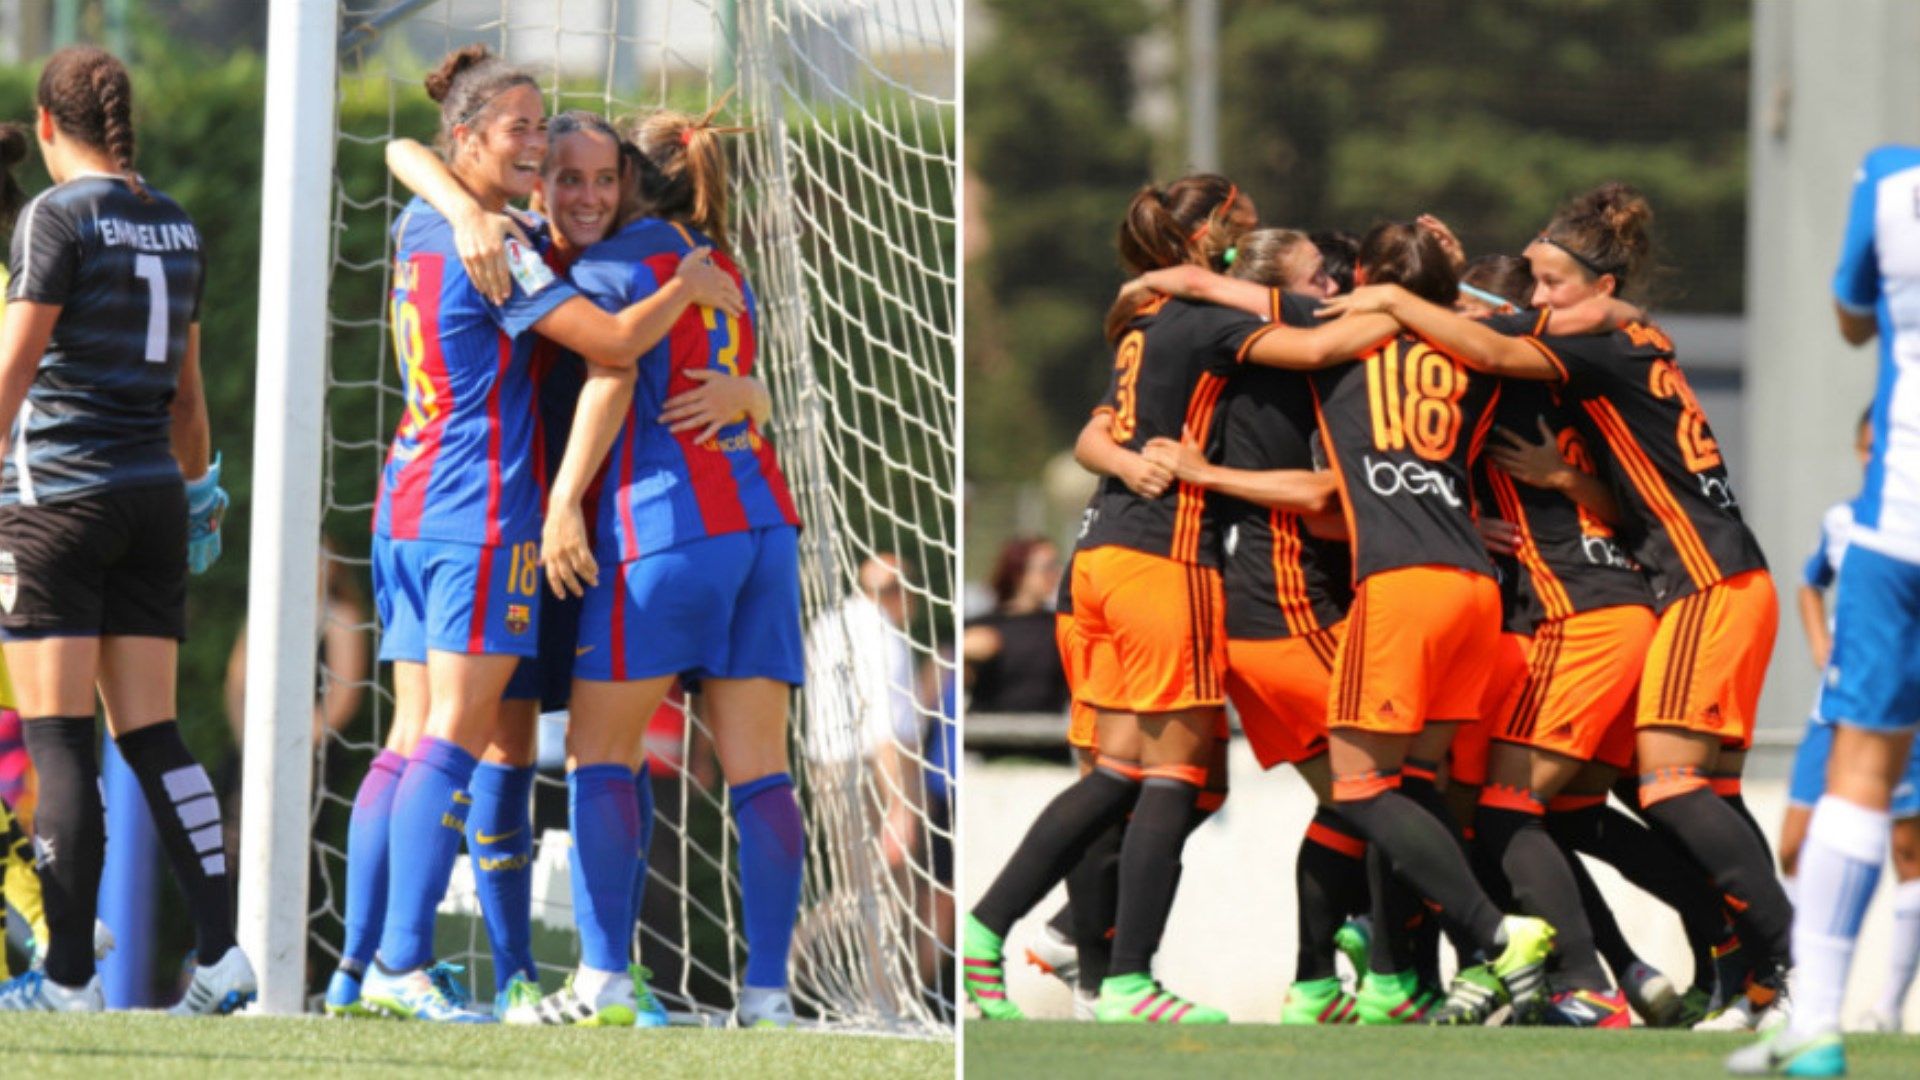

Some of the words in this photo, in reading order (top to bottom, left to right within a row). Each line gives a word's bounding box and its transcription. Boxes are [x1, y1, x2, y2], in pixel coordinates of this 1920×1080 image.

[134, 252, 169, 365] 1
[1366, 339, 1469, 462] 18
[507, 541, 537, 596] 18
